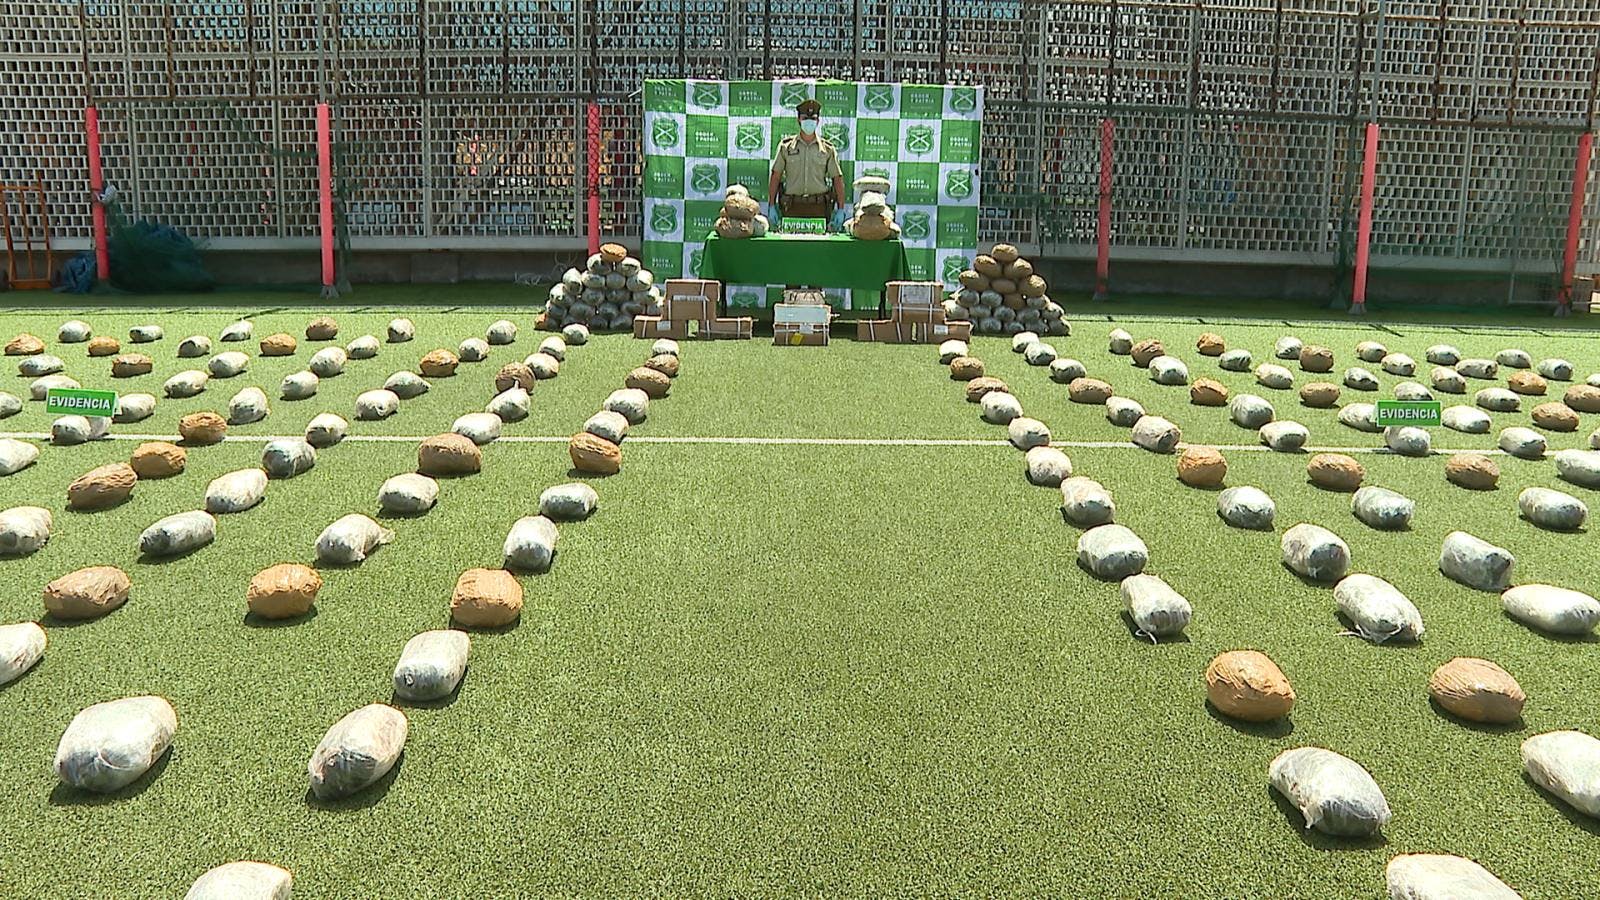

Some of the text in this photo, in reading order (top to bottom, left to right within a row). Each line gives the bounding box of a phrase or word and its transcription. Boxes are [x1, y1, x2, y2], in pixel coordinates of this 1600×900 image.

[783, 221, 823, 230] EVIDENCIA
[49, 395, 111, 410] EVIDENCIA
[1380, 408, 1438, 419] EVIDENCIA
